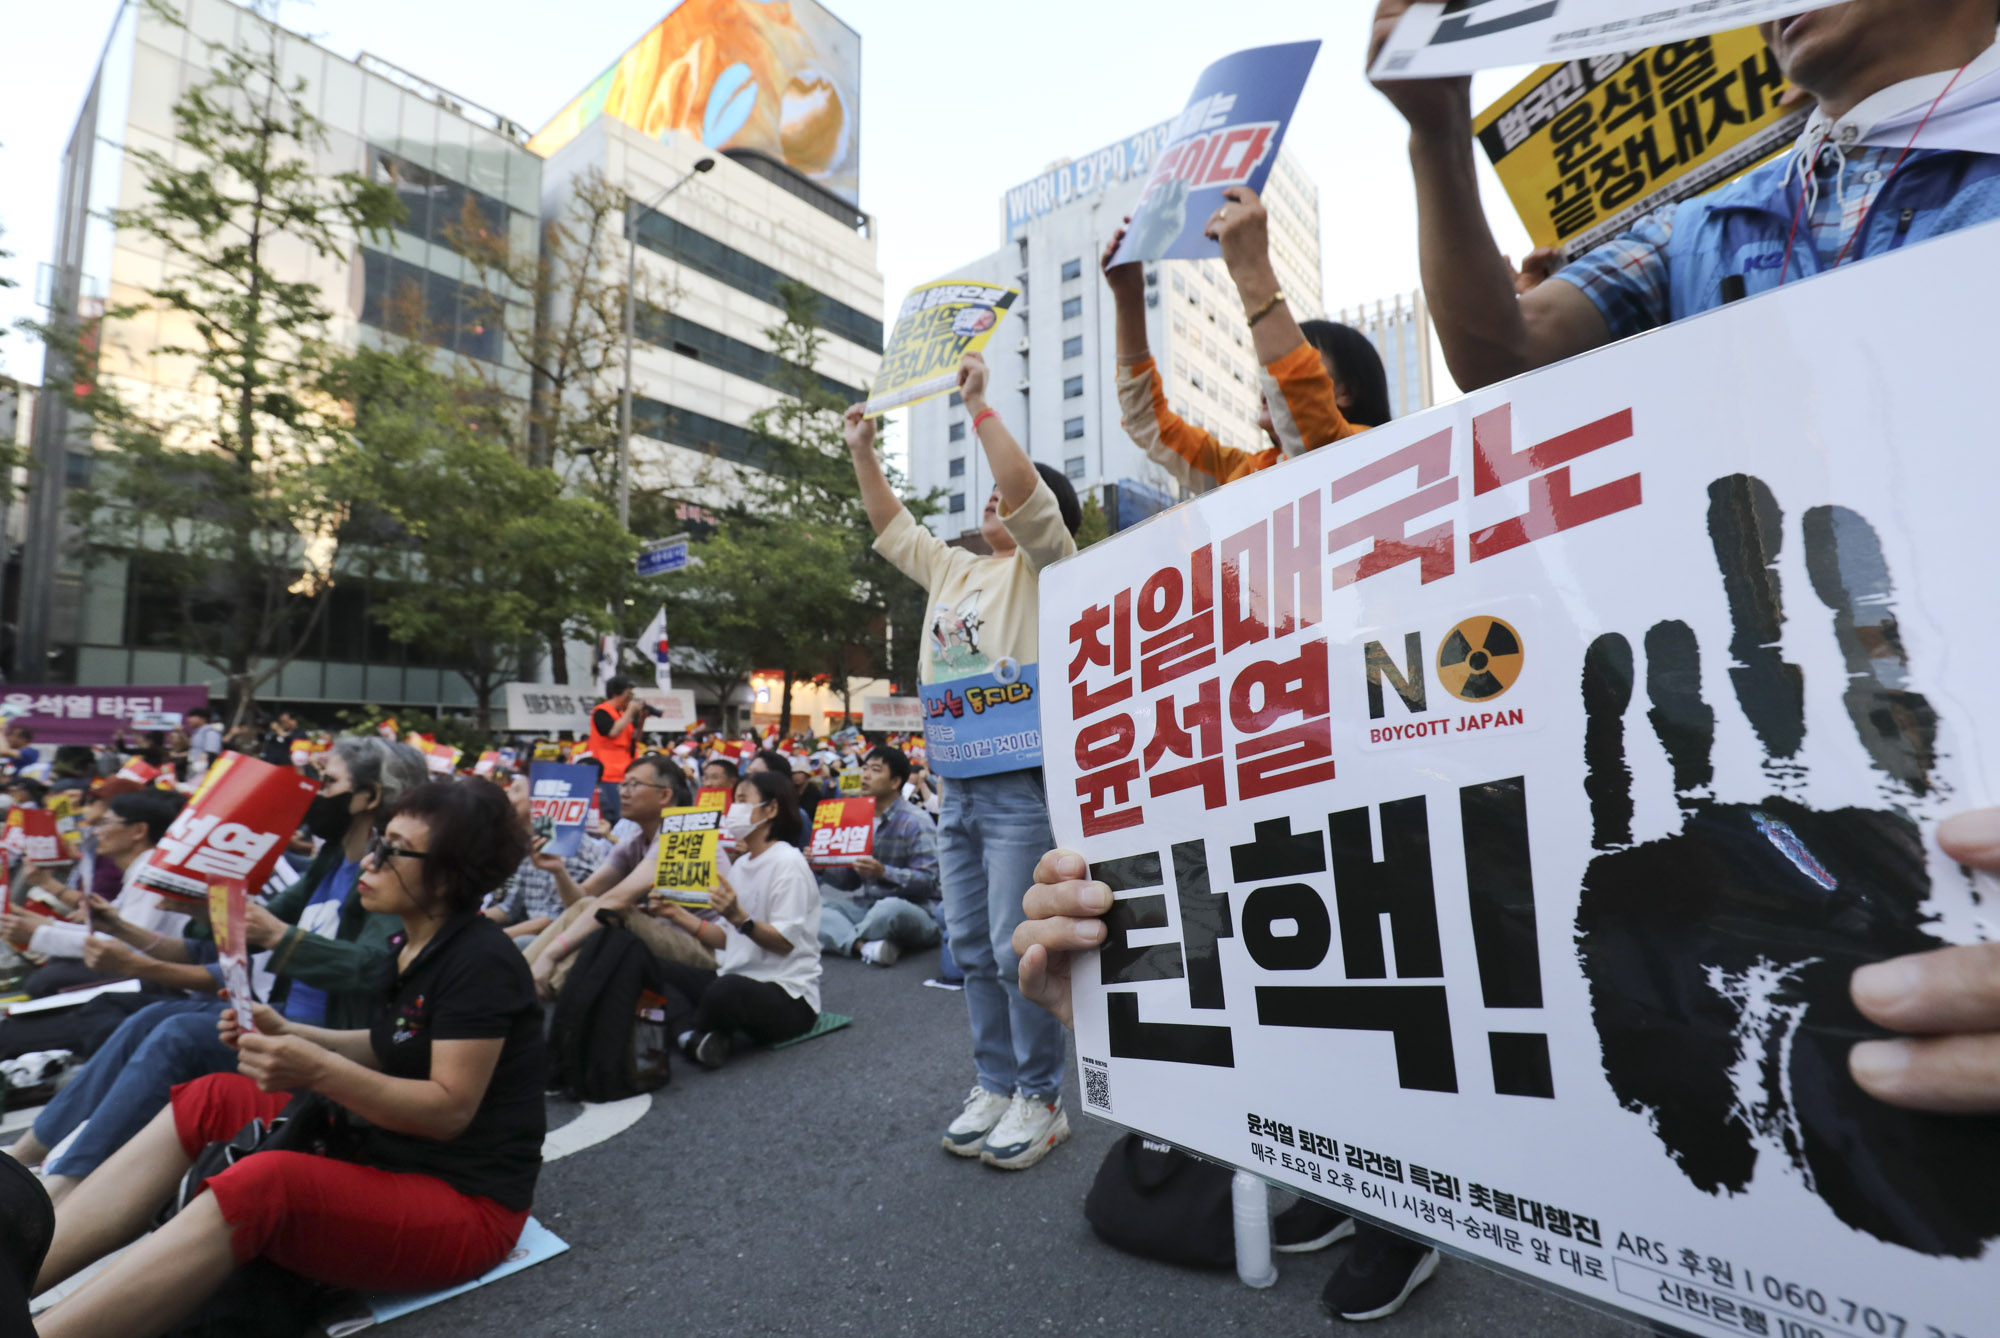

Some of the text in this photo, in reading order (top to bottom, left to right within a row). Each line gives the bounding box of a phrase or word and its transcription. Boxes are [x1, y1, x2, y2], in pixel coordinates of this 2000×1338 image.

[1497, 61, 1587, 152] 범국민
[1545, 45, 1785, 240] 끝장내자!
[1549, 34, 1717, 178] 윤석열
[1008, 166, 1072, 223] WORLD
[1075, 141, 1127, 195] EXPO
[1068, 401, 1643, 720] 친일매국노
[963, 740, 993, 759] 이길
[1075, 636, 1336, 838] 윤석열
[1370, 708, 1525, 744] BOYCOTT JAPAN
[665, 833, 705, 860] 윤석열
[812, 825, 870, 856] 윤석열
[1089, 775, 1555, 1099] 탄핵!
[1247, 1112, 1604, 1249] 윤석열 퇴진! 김건희 특검! 촛불대행진
[1251, 1142, 1278, 1166] 매주
[1281, 1152, 1323, 1184] 토요일
[1327, 1168, 1358, 1196] 오후
[1361, 1180, 1387, 1207] 6시
[1402, 1195, 1525, 1256] 시청역-숭례문
[1530, 1237, 1553, 1267] 앞
[1559, 1248, 1609, 1284] 대로
[1616, 1231, 1669, 1267] ARS
[1677, 1247, 1736, 1289] 후원
[1656, 1278, 1770, 1337] 신한은행
